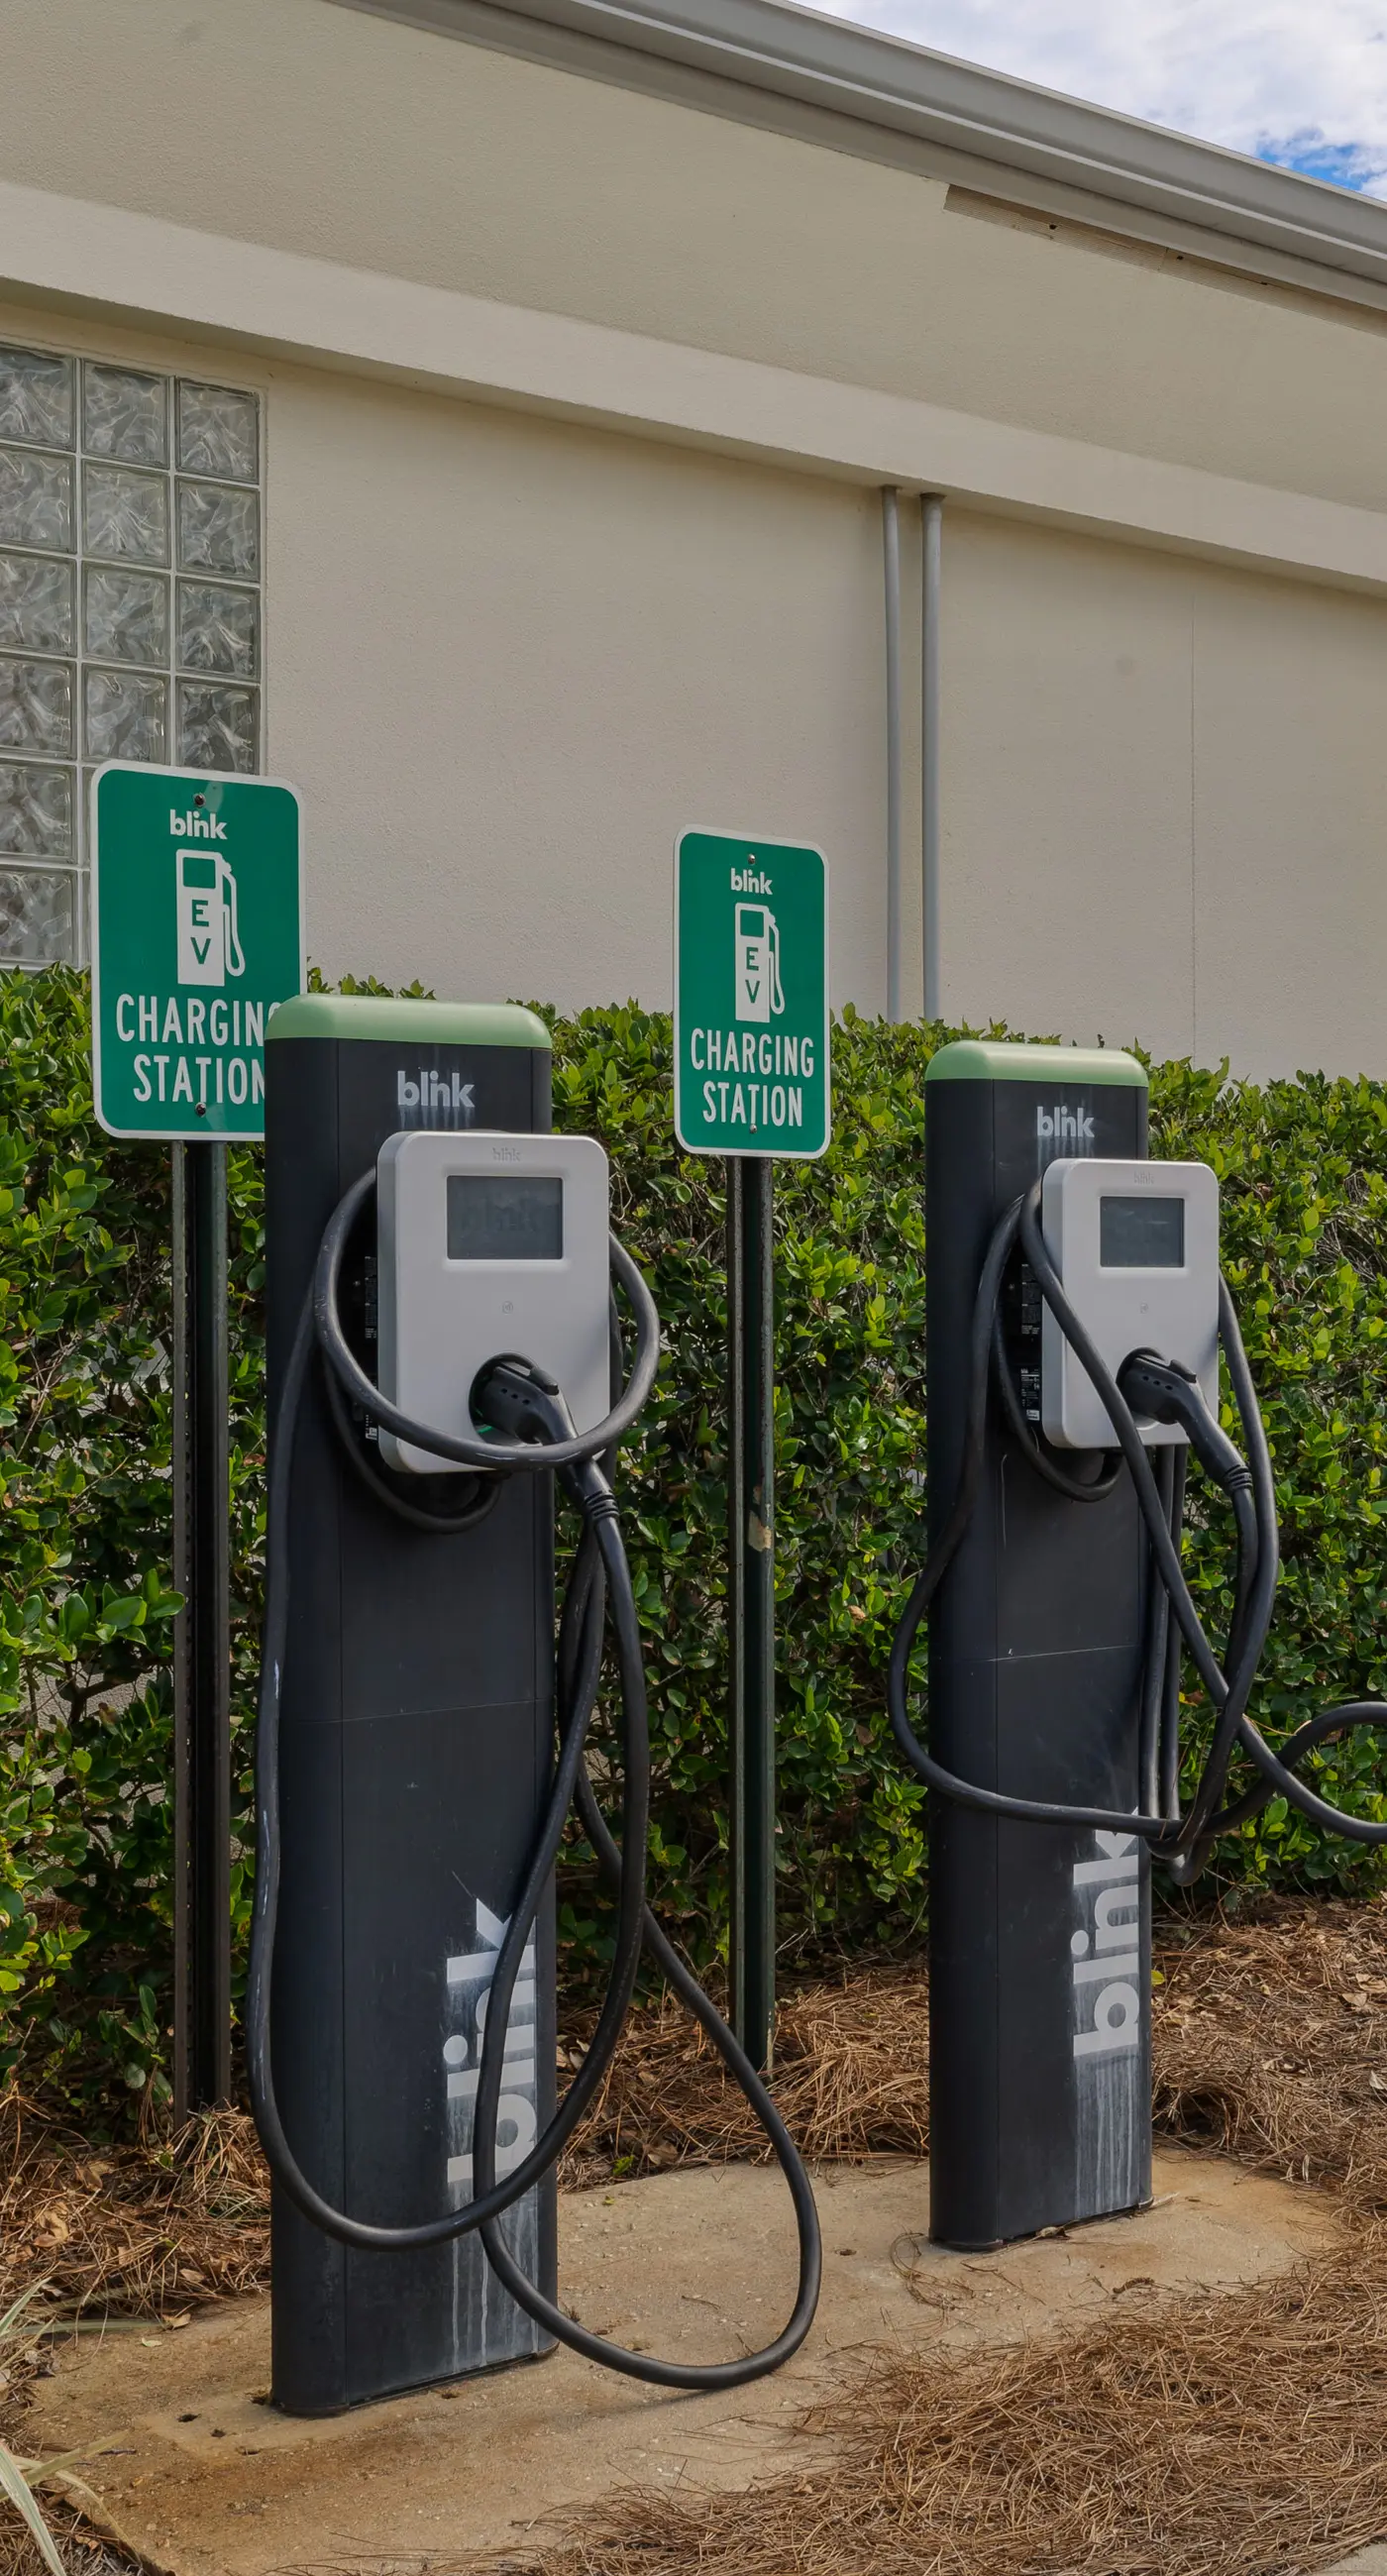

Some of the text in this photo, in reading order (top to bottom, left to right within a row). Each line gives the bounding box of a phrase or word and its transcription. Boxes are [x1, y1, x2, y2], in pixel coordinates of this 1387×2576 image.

[169, 809, 228, 840] blink
[730, 868, 773, 896] blink
[116, 994, 281, 1047] CHARGIN
[691, 1027, 814, 1078] CHARGING
[397, 1070, 476, 1108] blink
[702, 1081, 803, 1127] STATION
[1036, 1106, 1095, 1138] blink
[491, 1146, 521, 1162] blink
[1071, 1806, 1140, 2057] blink
